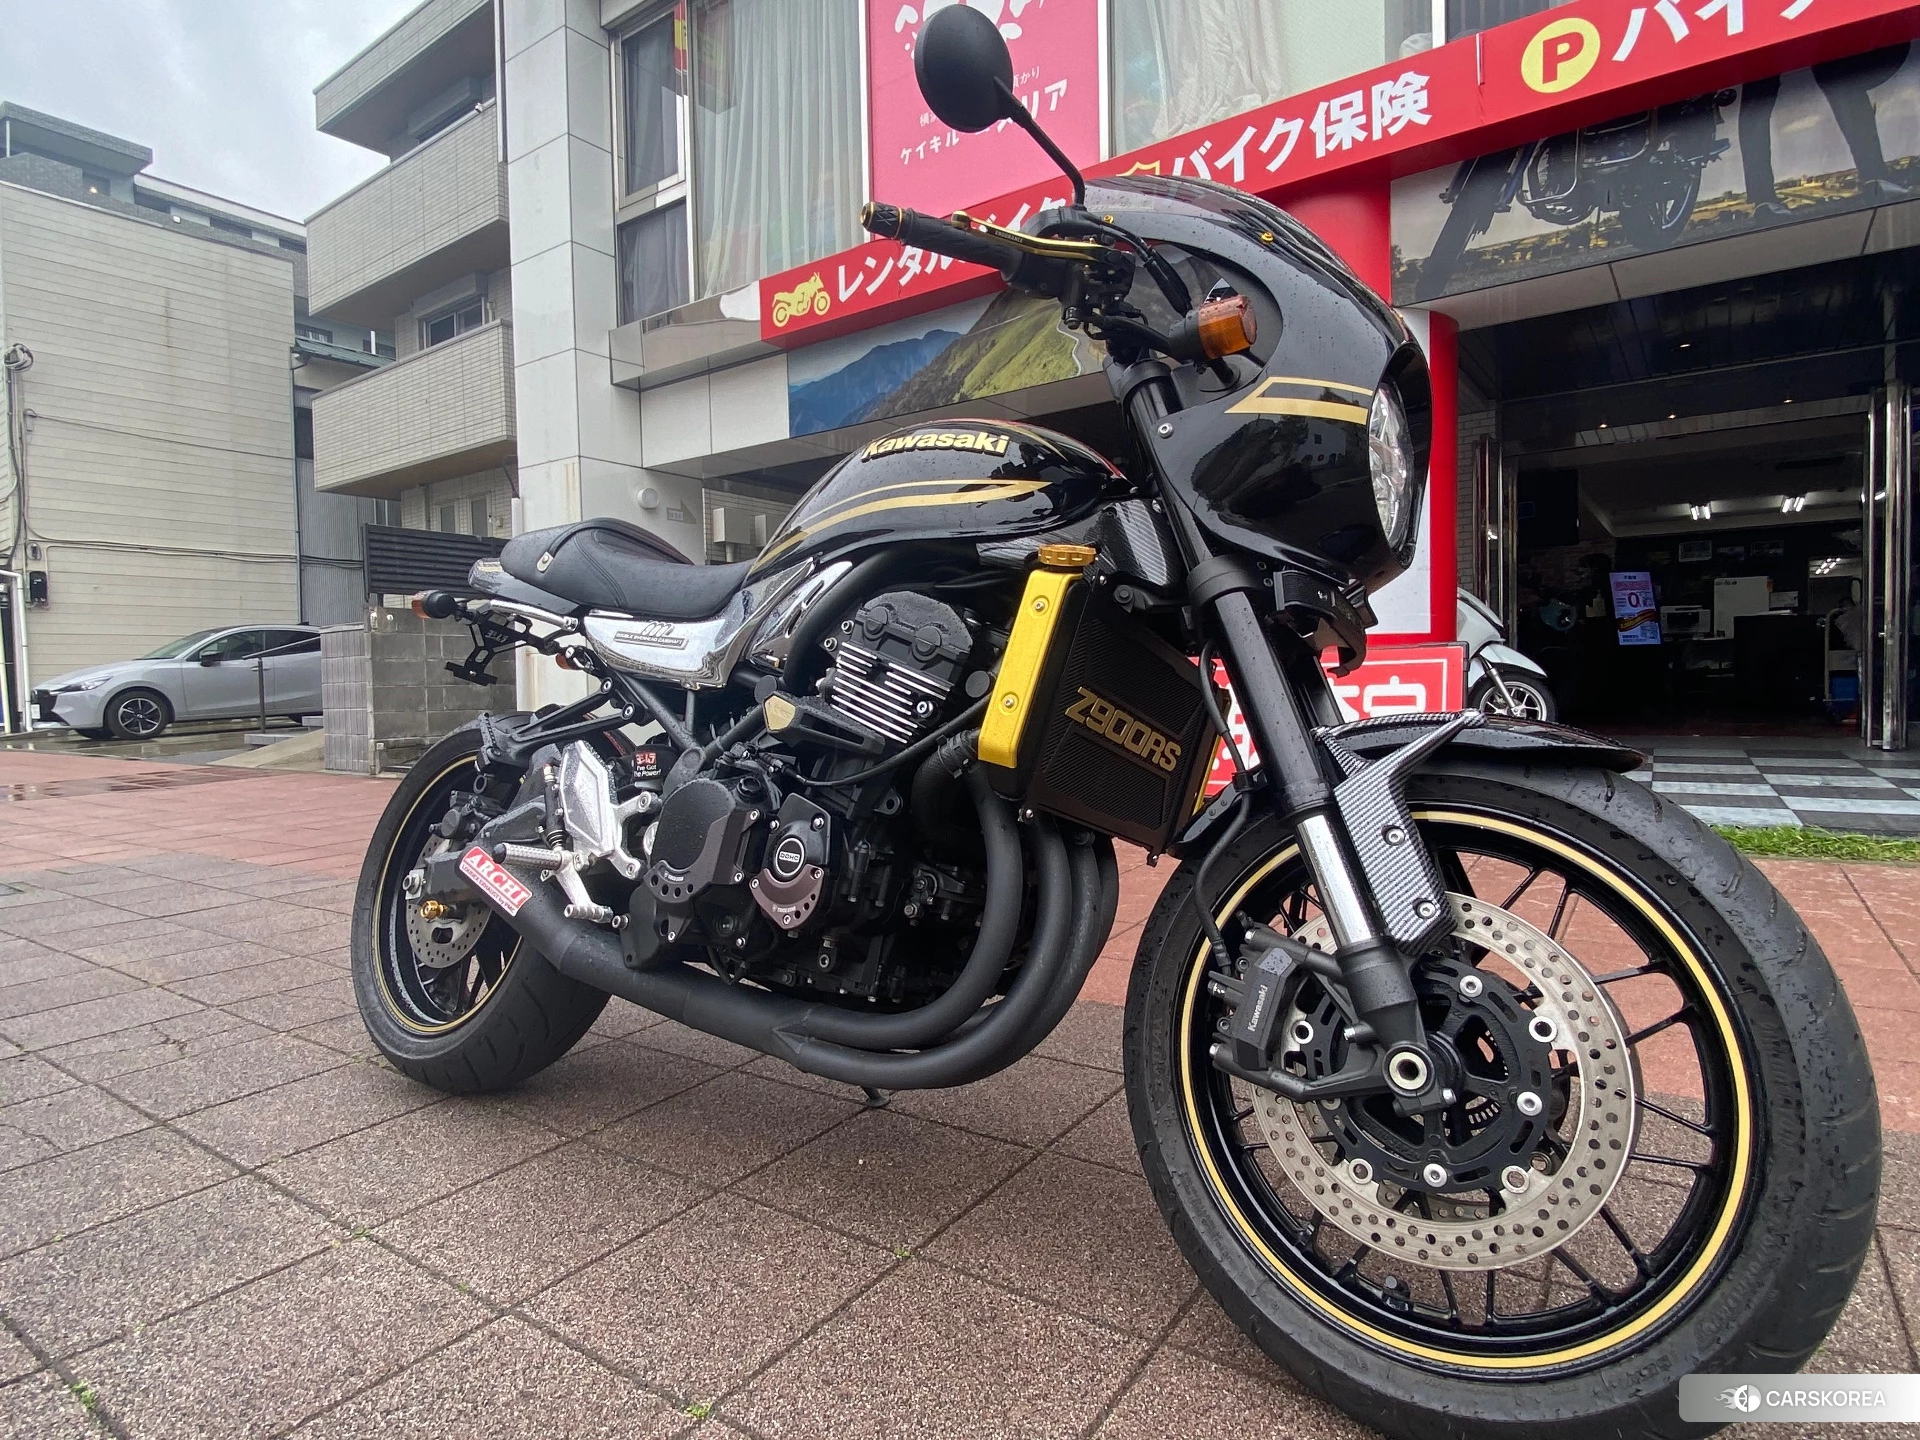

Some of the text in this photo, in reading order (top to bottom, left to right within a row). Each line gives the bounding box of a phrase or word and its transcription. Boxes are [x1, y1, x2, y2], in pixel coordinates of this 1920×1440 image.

[1171, 70, 1433, 183] バイク保険
[861, 431, 1011, 461] Kawasaki
[1065, 686, 1182, 772] Z900RS
[464, 854, 529, 907] ARCHI
[1247, 984, 1269, 1032] Kawasaki
